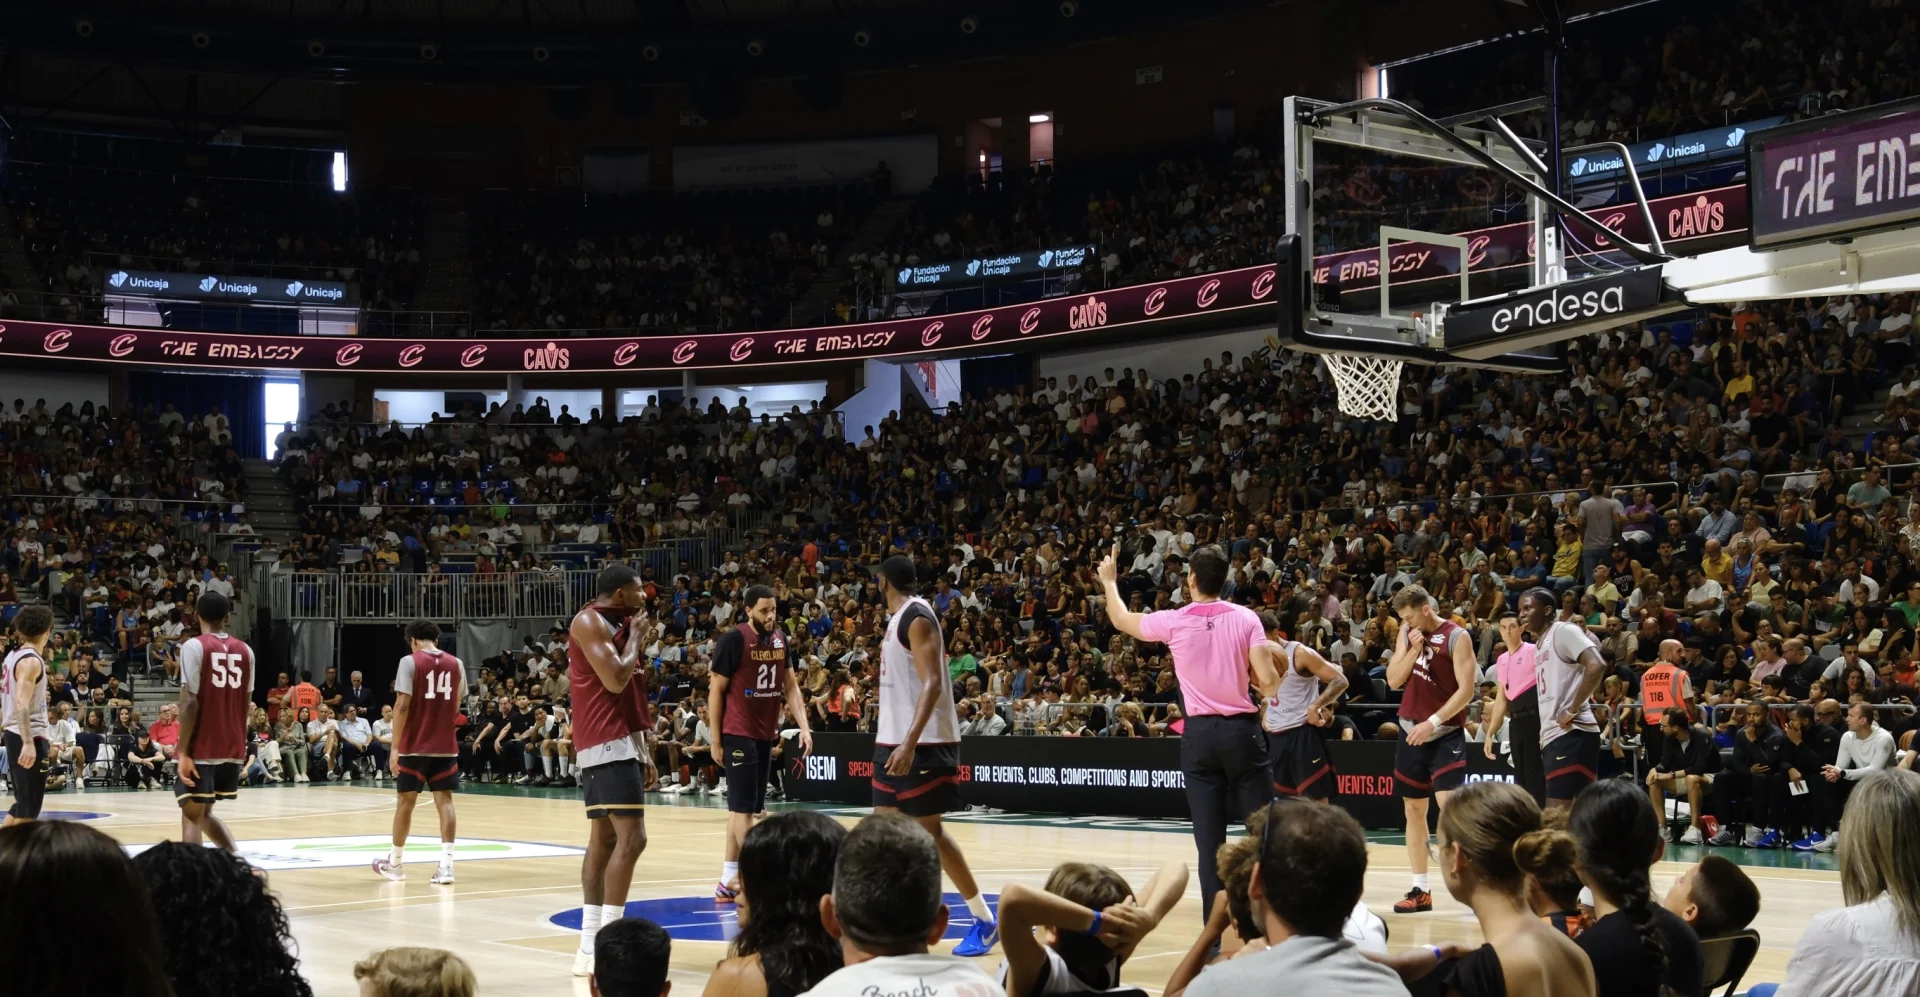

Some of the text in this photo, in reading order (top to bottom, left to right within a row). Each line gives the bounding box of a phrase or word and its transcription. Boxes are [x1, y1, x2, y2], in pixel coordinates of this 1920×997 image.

[1776, 150, 1836, 219] THE
[1669, 197, 1724, 237] CAVS
[913, 264, 950, 276] Fundación
[983, 256, 1021, 267] Fundación
[983, 265, 1010, 276] Unicaja
[1313, 250, 1431, 284] HE EMBSSY
[130, 277, 169, 291] Unicaja
[219, 282, 258, 296] Unicaja
[913, 274, 940, 284] Unicaja
[305, 287, 343, 300] Unicaja
[1070, 297, 1107, 329] CAVS
[1315, 301, 1340, 312] ndesa
[1492, 286, 1624, 333] endesa
[161, 340, 304, 360] THE EMBASSY
[774, 330, 896, 355] THE EMBASSY
[524, 343, 570, 370] CAVS
[751, 650, 785, 660] CLEVELAND
[211, 652, 243, 689] 55
[756, 663, 777, 689] 21
[1645, 673, 1670, 681] COFER
[424, 669, 453, 700] 14
[1649, 692, 1664, 702] 118
[805, 755, 836, 781] ISEM
[975, 765, 991, 782] FOR
[992, 766, 1027, 785] EVENTS,
[1028, 767, 1059, 786] CLUBS,
[1060, 768, 1127, 786] COMPETITIONS
[1129, 770, 1150, 787] AND
